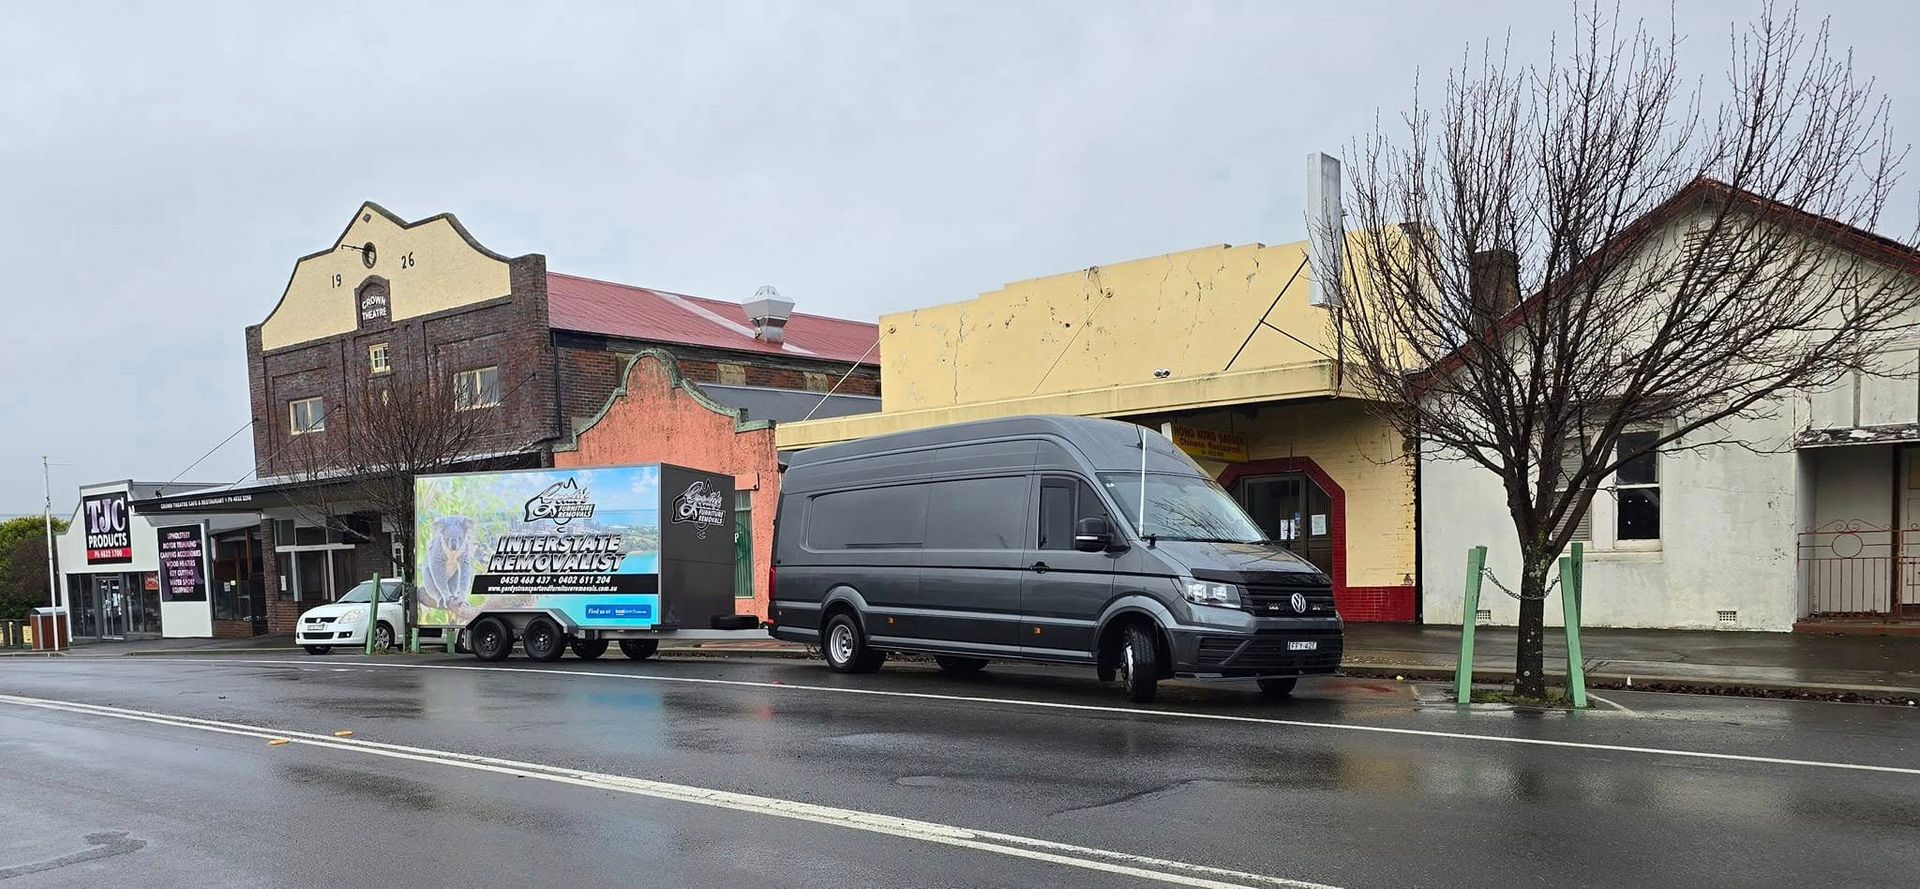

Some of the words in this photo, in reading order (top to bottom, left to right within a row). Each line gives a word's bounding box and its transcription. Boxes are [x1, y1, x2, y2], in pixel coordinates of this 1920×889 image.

[331, 274, 342, 288] 19
[401, 252, 415, 269] 26
[361, 296, 386, 310] CROWN
[361, 307, 387, 320] THEATRE
[86, 497, 126, 534] TJC
[559, 504, 593, 512] FURNITURE
[88, 533, 128, 548] PRODUCTS
[496, 535, 622, 554] INTERSTATE
[486, 553, 627, 573] REMOVALIST
[500, 576, 519, 584] 0450
[520, 576, 535, 584] 468
[536, 576, 551, 584] 437
[558, 575, 577, 584] 0402
[579, 575, 594, 584] 611
[596, 575, 612, 584] 204
